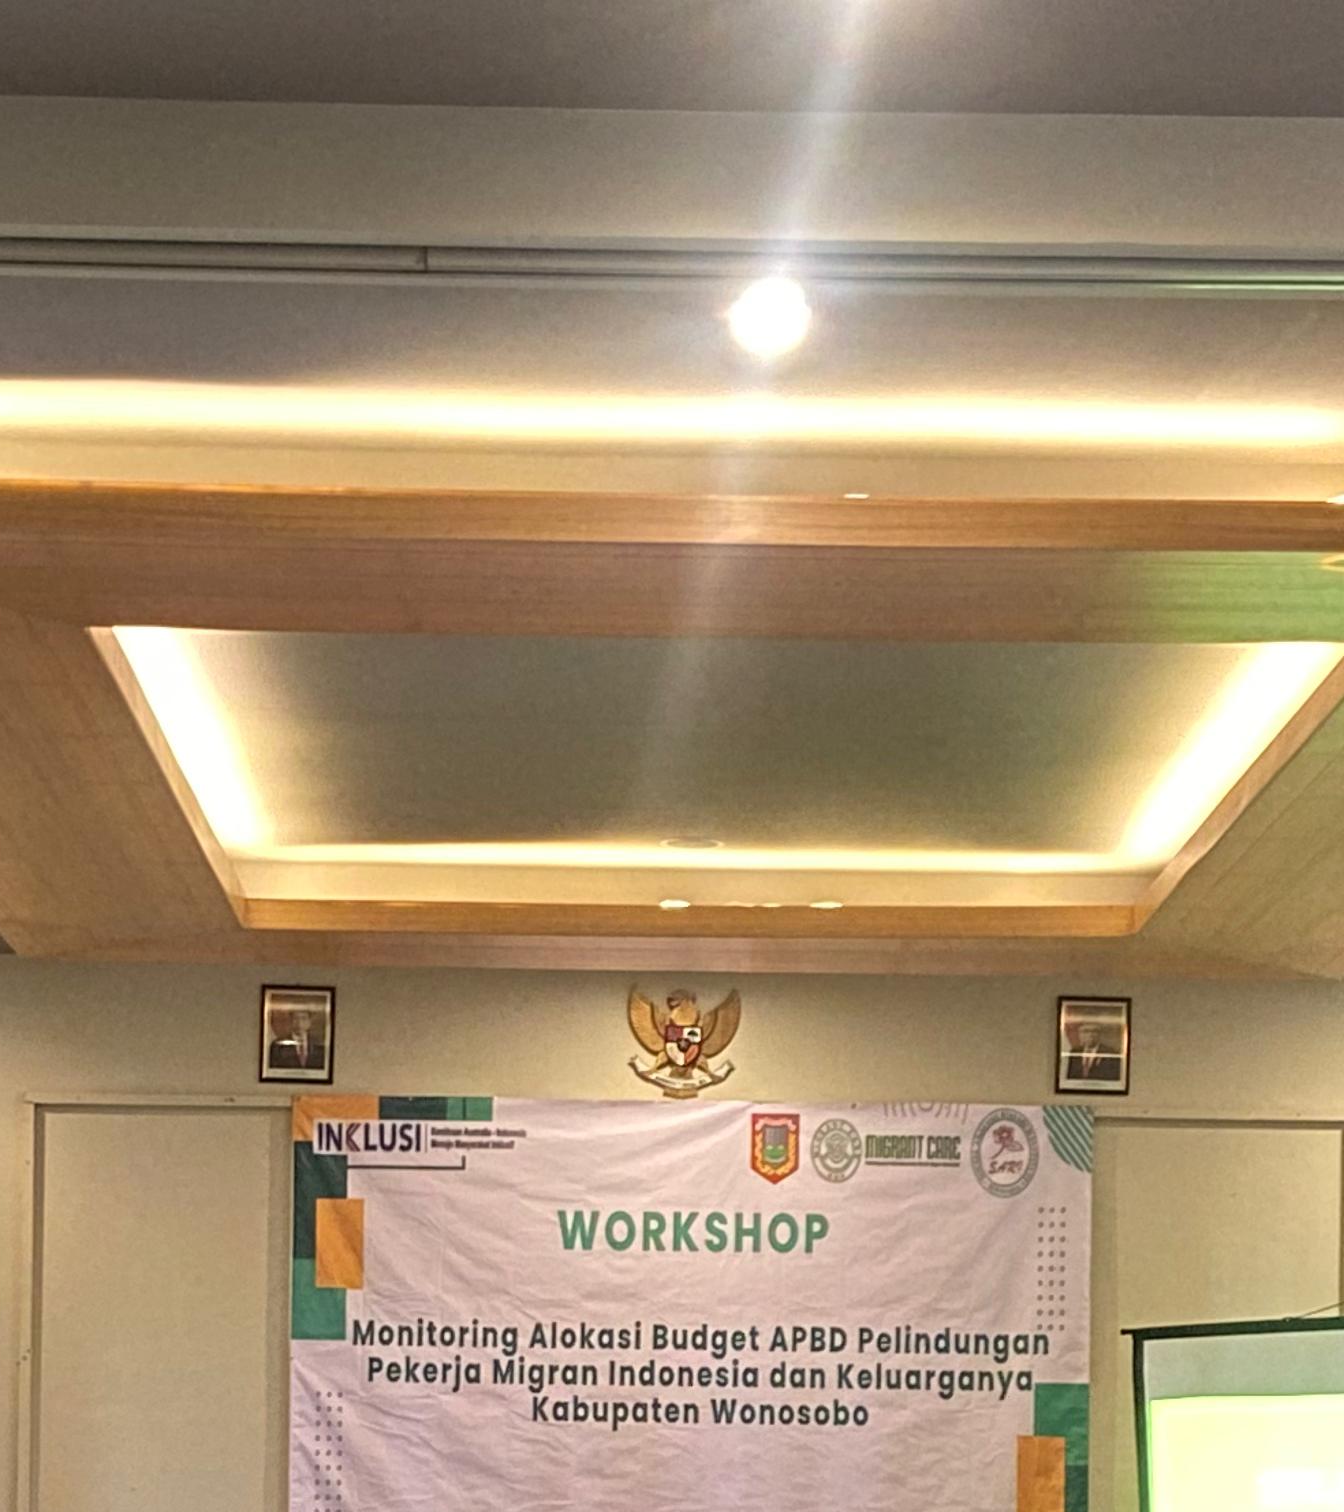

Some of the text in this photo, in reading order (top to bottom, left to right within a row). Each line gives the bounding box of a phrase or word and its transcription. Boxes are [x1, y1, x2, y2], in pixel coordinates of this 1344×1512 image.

[317, 1122, 421, 1152] INKLUSI
[865, 1134, 961, 1160] MIGRANT CARE
[557, 1210, 830, 1254] WORKSHOP
[352, 1318, 1050, 1363] Monitoring Alokasi Budget APBD Pelindungan
[367, 1355, 1033, 1400] Pekerja Migran Indonesia dan Keluarganya
[532, 1396, 869, 1431] Kabupaten Wonosobo
